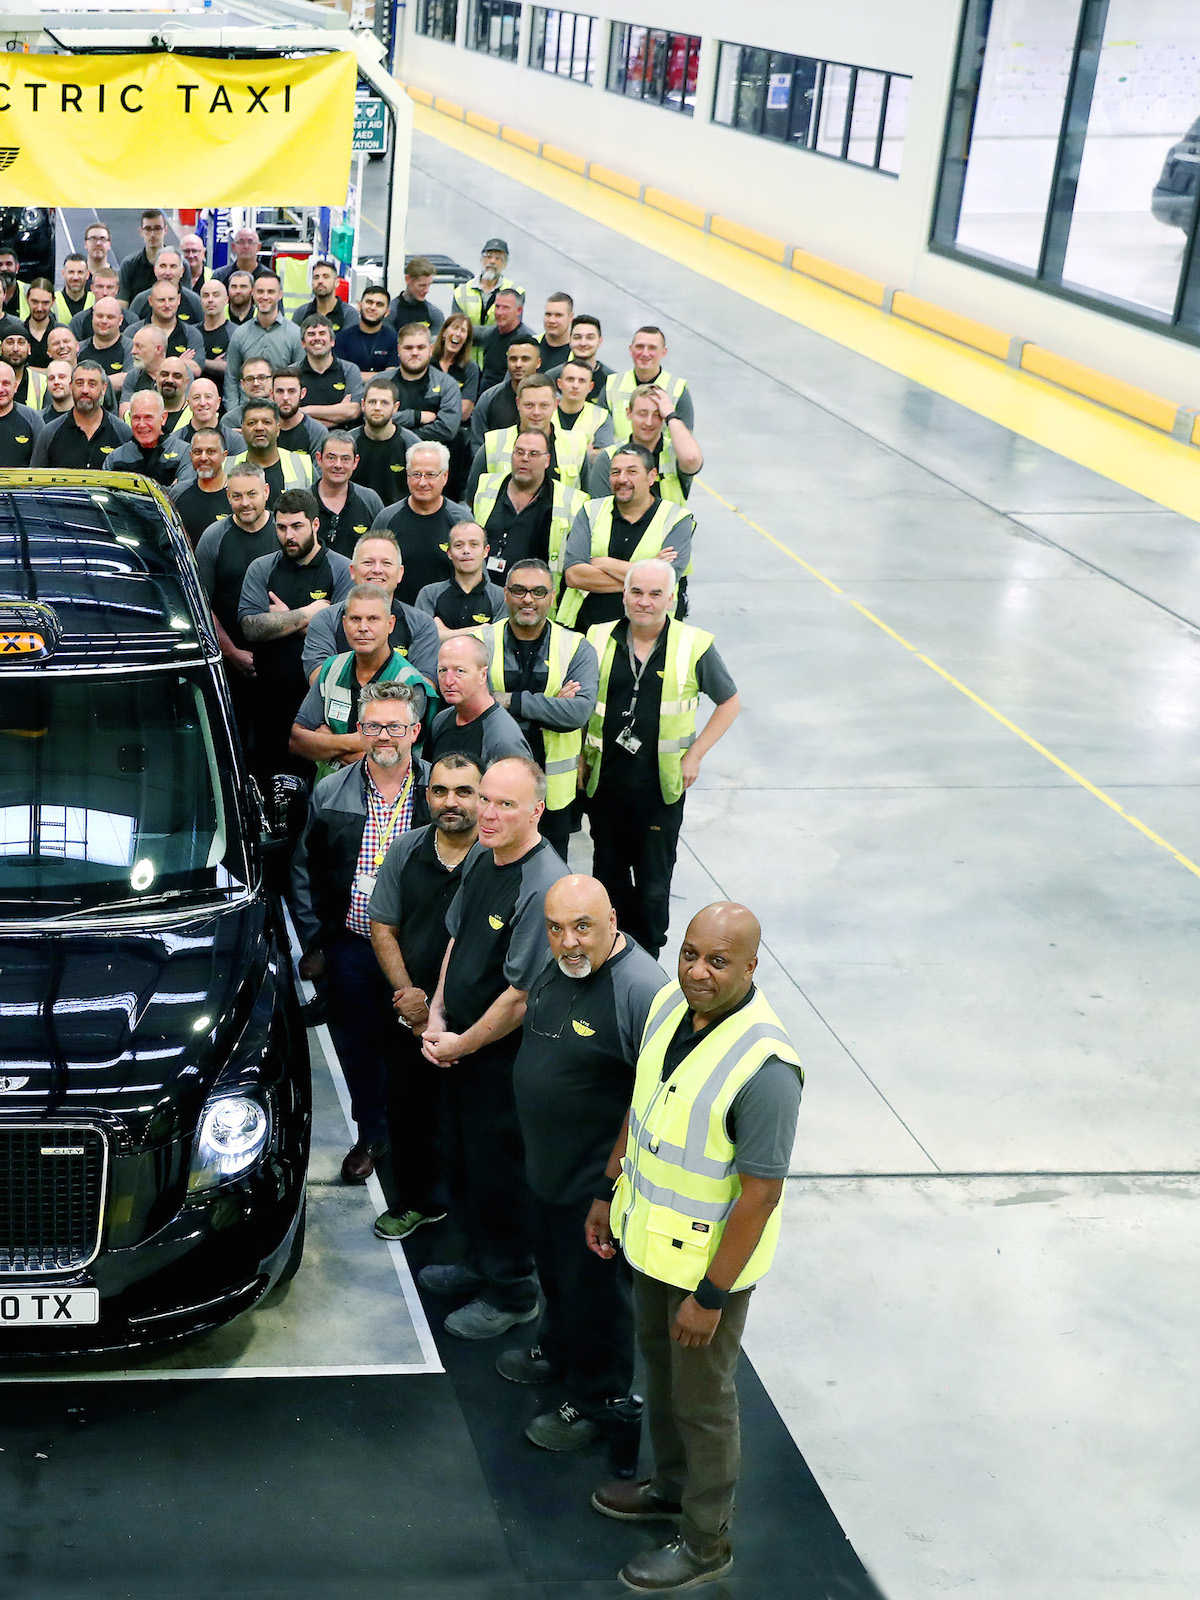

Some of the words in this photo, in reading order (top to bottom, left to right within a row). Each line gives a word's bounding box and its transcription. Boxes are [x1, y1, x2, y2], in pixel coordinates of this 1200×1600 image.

[176, 84, 291, 113] TAXI
[367, 120, 383, 129] AID
[356, 130, 374, 139] AED
[31, 1294, 73, 1319] TX
